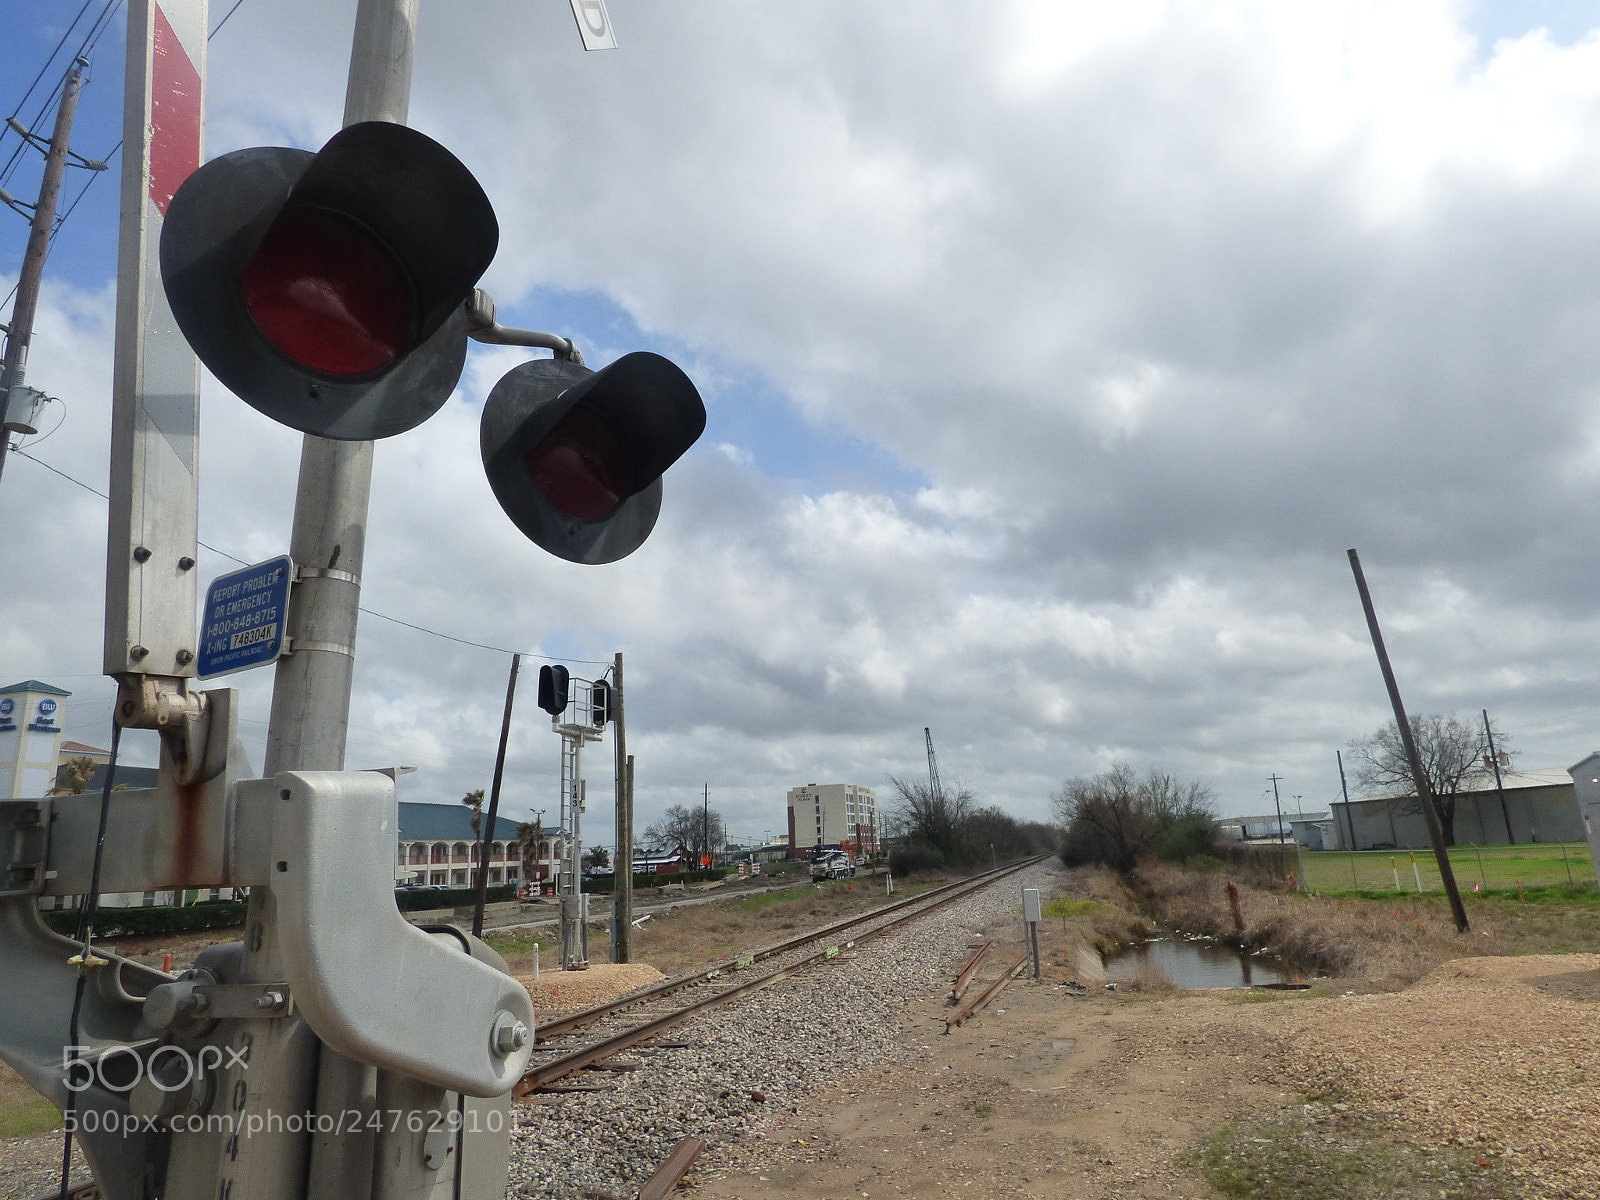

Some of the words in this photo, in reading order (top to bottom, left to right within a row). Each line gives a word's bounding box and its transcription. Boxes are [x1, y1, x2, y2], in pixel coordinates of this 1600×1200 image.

[212, 583, 241, 603] REPORT
[214, 605, 226, 619] OR
[226, 590, 273, 616] EMERGENCY
[207, 606, 277, 638] 1-800-848-8715
[206, 638, 228, 655] X-ING
[233, 625, 273, 648] 748304K
